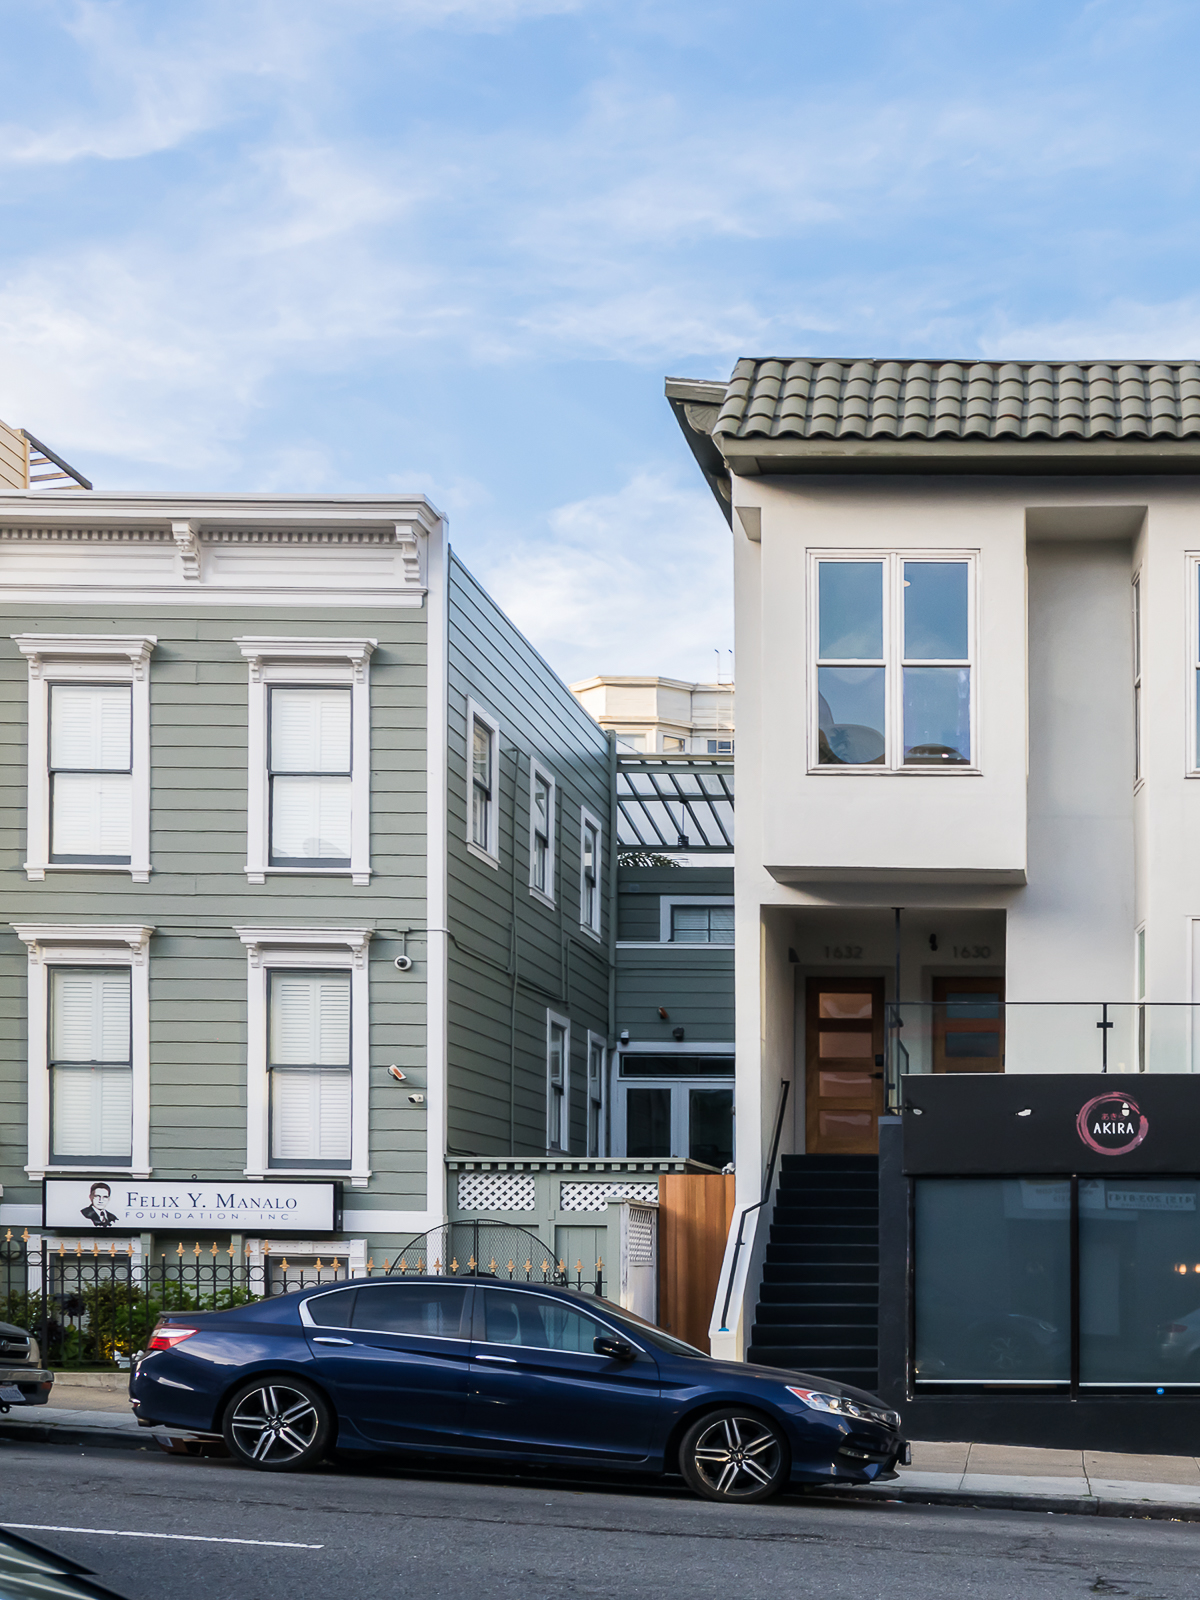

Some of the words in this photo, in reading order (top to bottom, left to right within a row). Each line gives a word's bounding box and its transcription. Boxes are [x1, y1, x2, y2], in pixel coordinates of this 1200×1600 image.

[824, 945, 863, 959] 1632
[953, 945, 991, 959] 1630
[1093, 1122, 1135, 1134] AKIRA
[126, 1191, 180, 1208] FELIX
[187, 1193, 206, 1208] Y.
[215, 1193, 298, 1210] MANALO
[260, 1213, 298, 1221] INC.
